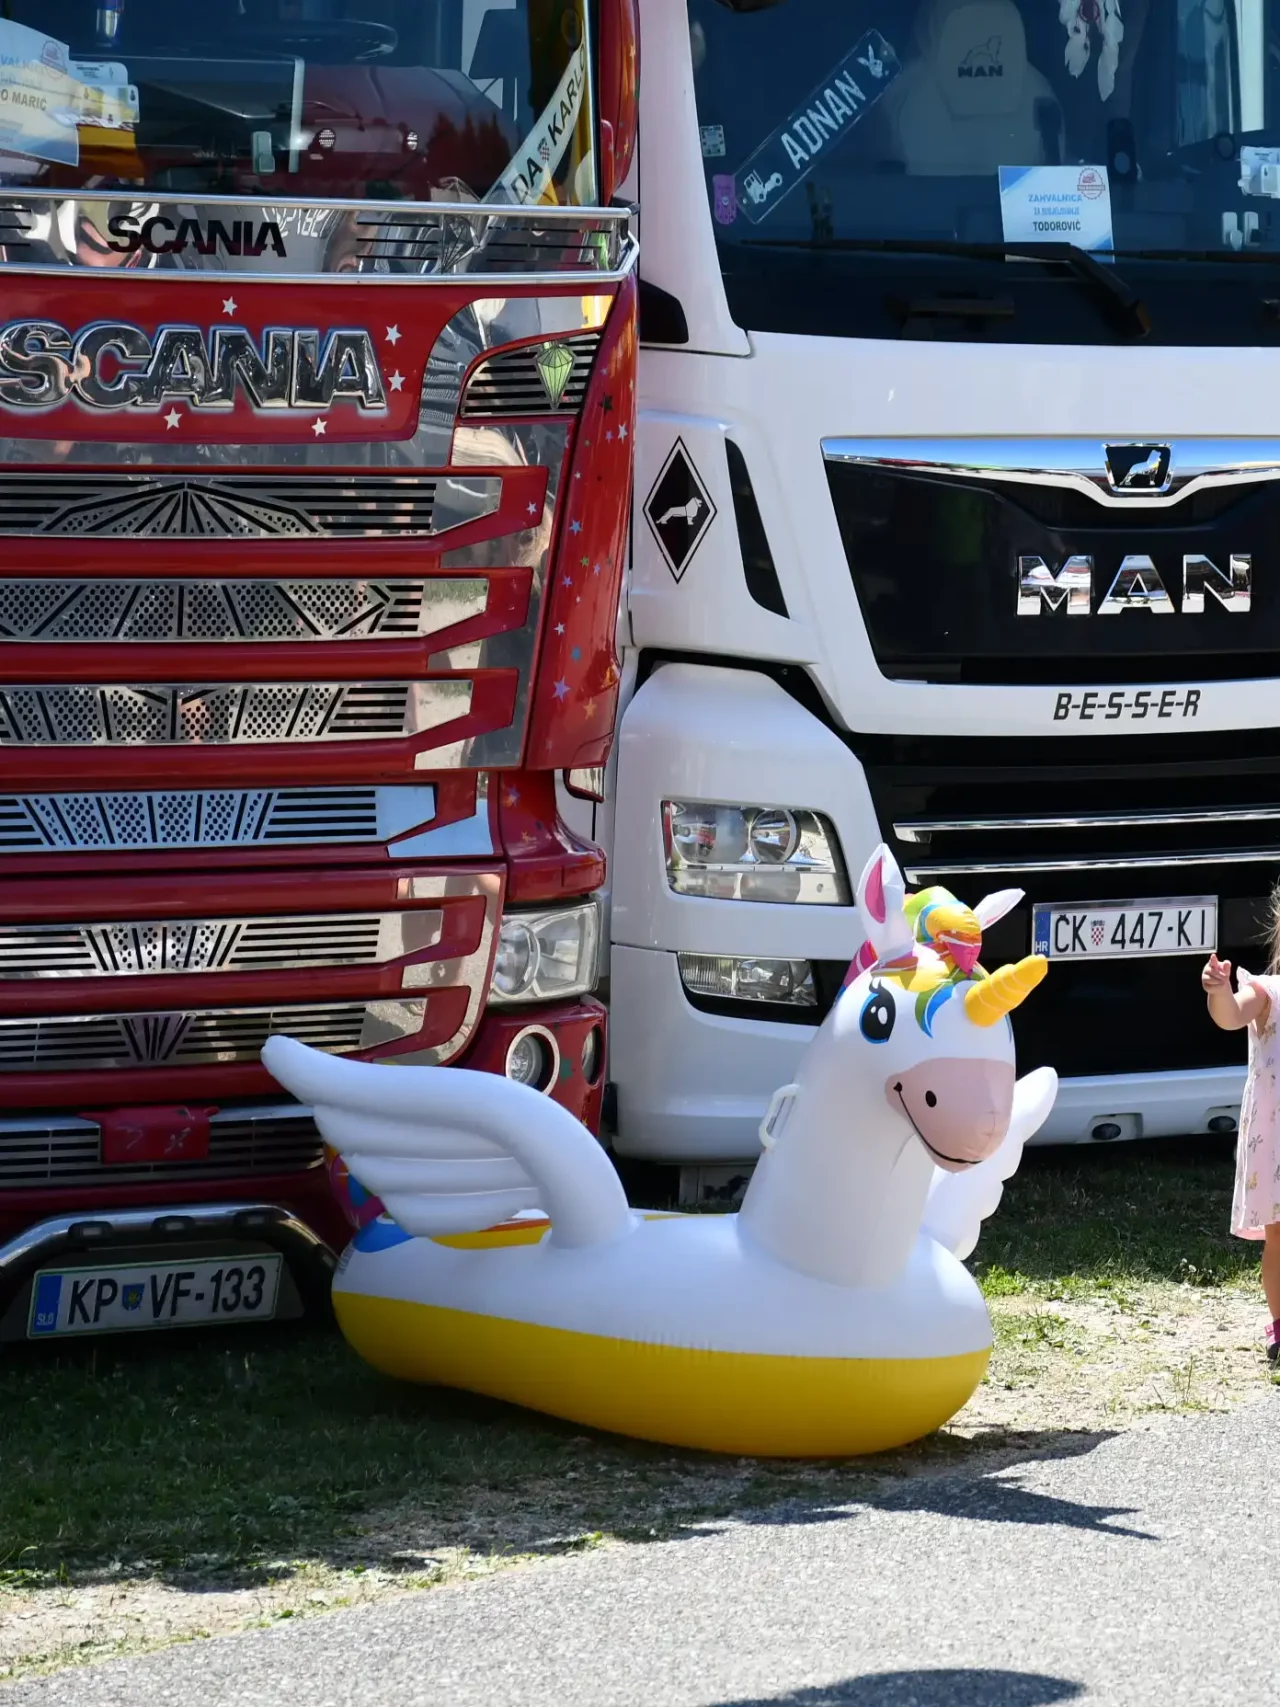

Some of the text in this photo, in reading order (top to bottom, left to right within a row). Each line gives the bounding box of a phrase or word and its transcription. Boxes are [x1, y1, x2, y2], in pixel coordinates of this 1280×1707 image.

[957, 64, 1003, 78] MAN
[547, 42, 585, 146] KARLO
[780, 70, 866, 169] ADNAN
[1028, 193, 1082, 203] ZAHVALNICA
[108, 215, 287, 258] SCANIA
[1032, 219, 1081, 232] TODOROVIĆ
[0, 320, 387, 409] SCANIA
[1017, 553, 1252, 615] MAN
[1035, 940, 1048, 952] HR
[1054, 914, 1088, 953] ČK
[67, 1265, 266, 1325] KP VF-133
[36, 1313, 54, 1326] SLO
